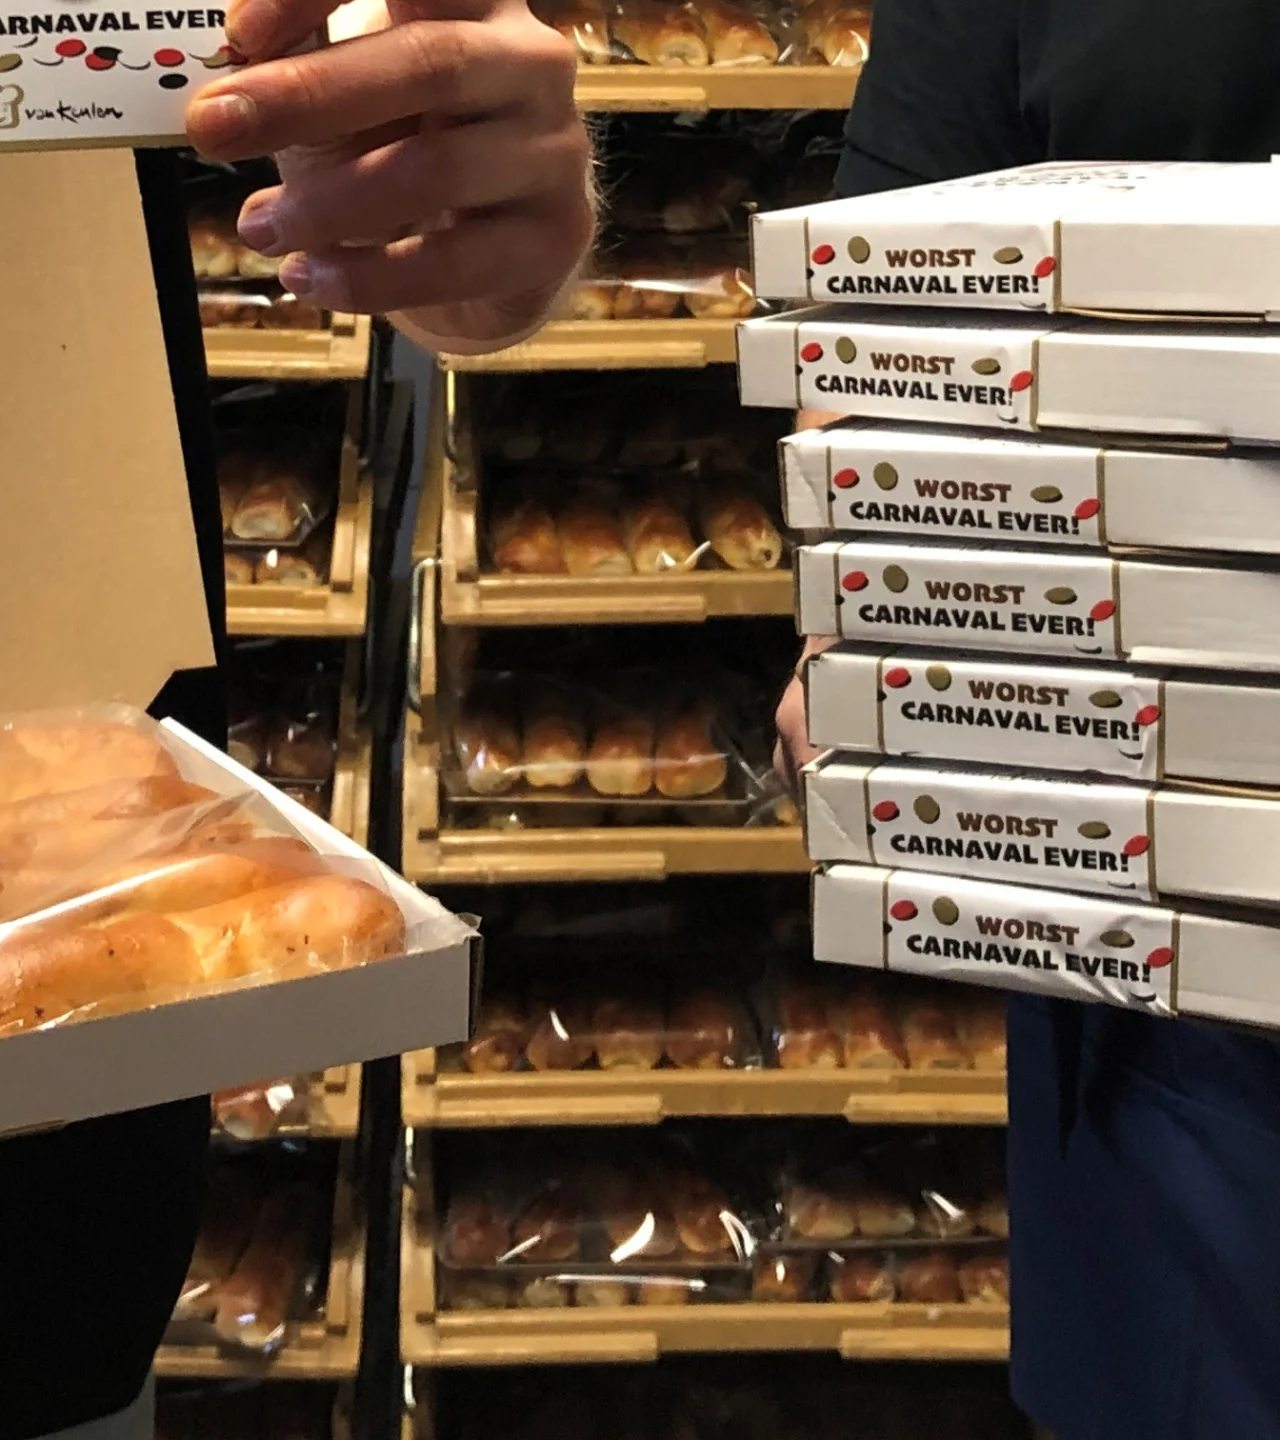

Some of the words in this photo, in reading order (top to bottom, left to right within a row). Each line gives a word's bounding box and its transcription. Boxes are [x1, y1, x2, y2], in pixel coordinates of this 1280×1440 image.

[885, 249, 976, 268] WORST
[827, 275, 957, 294] CARNAVAL
[963, 275, 1040, 294] EVER!
[870, 352, 954, 375] WORST
[815, 375, 938, 401] CARNAVAL
[943, 383, 1013, 406] EVER!
[914, 479, 1012, 503] WORST
[850, 501, 993, 530] CARNAVAL
[998, 510, 1080, 535] EVER!
[925, 581, 1025, 604] WORST
[859, 605, 1005, 632] CARNAVAL
[1012, 613, 1096, 637] EVER!
[968, 680, 1069, 707] WORST
[901, 702, 1049, 733] CARNAVAL
[1055, 714, 1140, 742] EVER!
[957, 812, 1058, 838] WORST
[890, 835, 1038, 865] CARNAVAL
[1044, 846, 1129, 872] EVER!
[975, 915, 1080, 946] WORST
[907, 935, 1058, 972] CARNAVAL
[1065, 953, 1150, 983] EVER!
